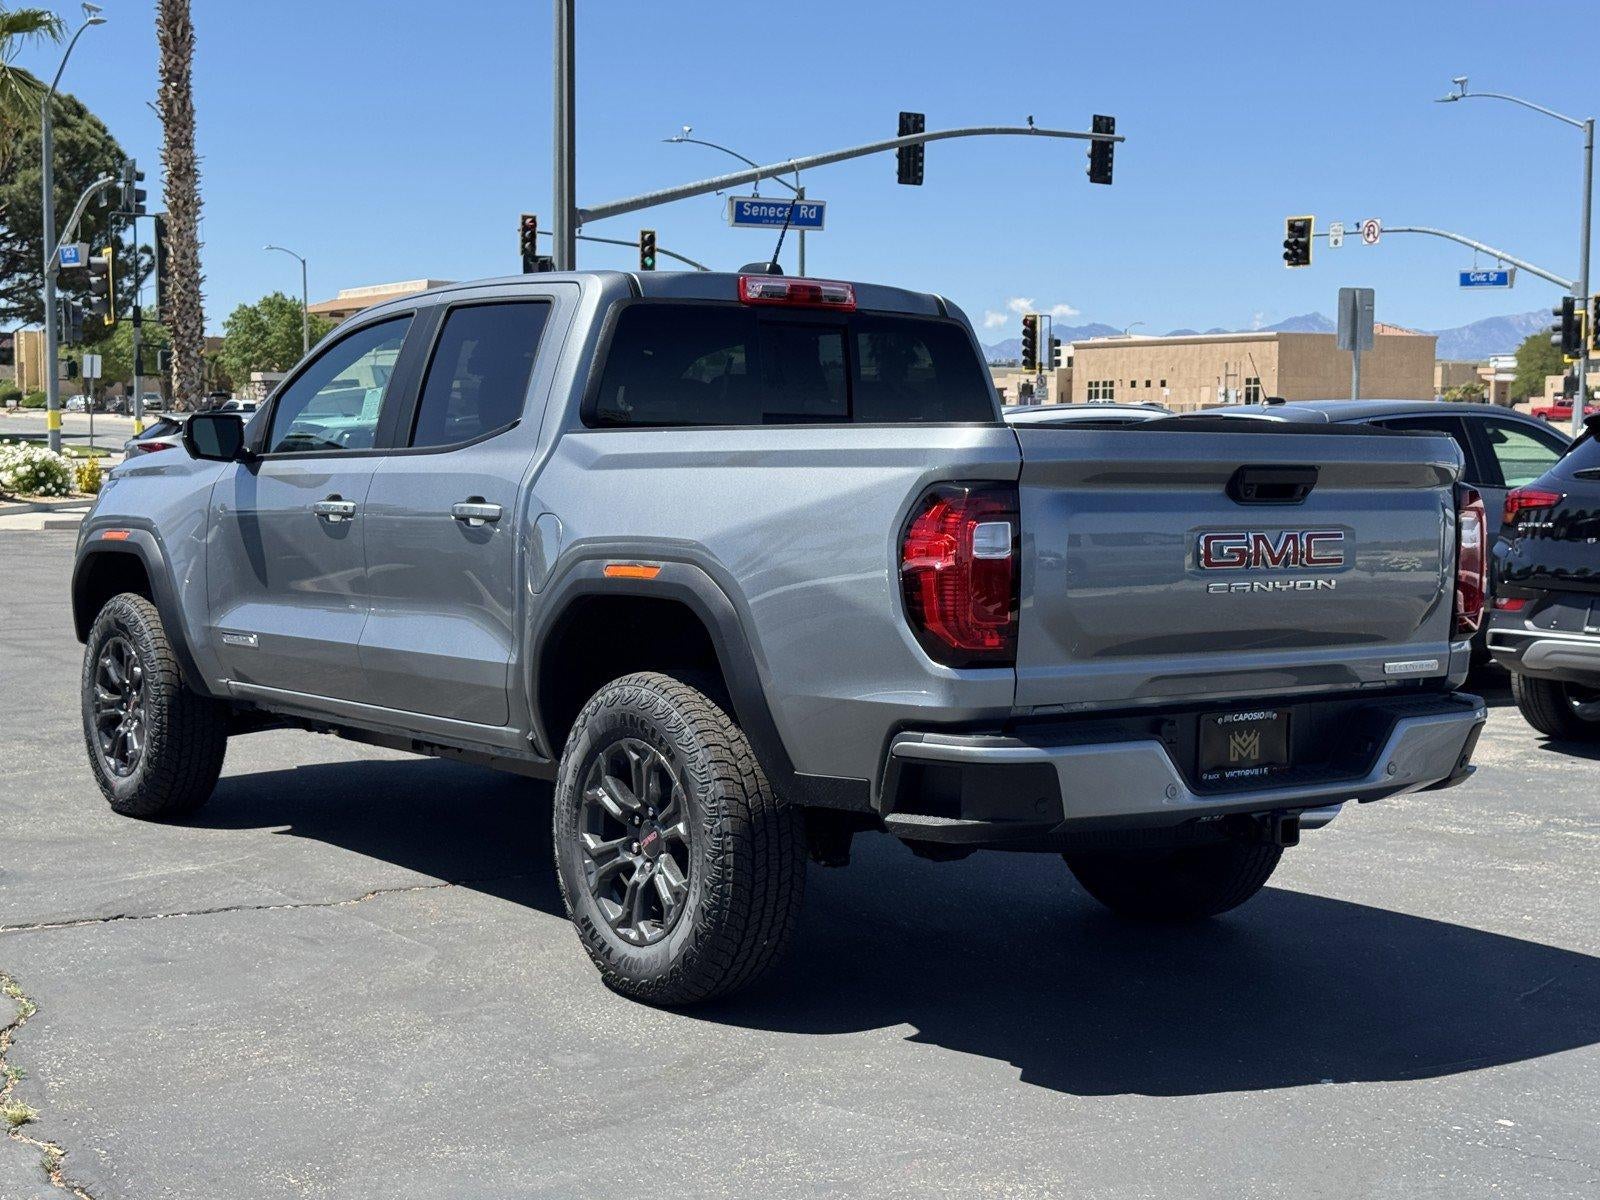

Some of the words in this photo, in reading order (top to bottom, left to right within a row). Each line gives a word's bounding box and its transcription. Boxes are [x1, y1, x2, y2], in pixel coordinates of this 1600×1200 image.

[742, 202, 791, 217] Seneca
[800, 205, 817, 219] Rd
[1469, 271, 1487, 282] Civic
[1489, 271, 1498, 282] Dr
[1199, 531, 1344, 569] GMC
[1207, 579, 1336, 594] CANYON
[1233, 711, 1265, 722] CAPOSIO
